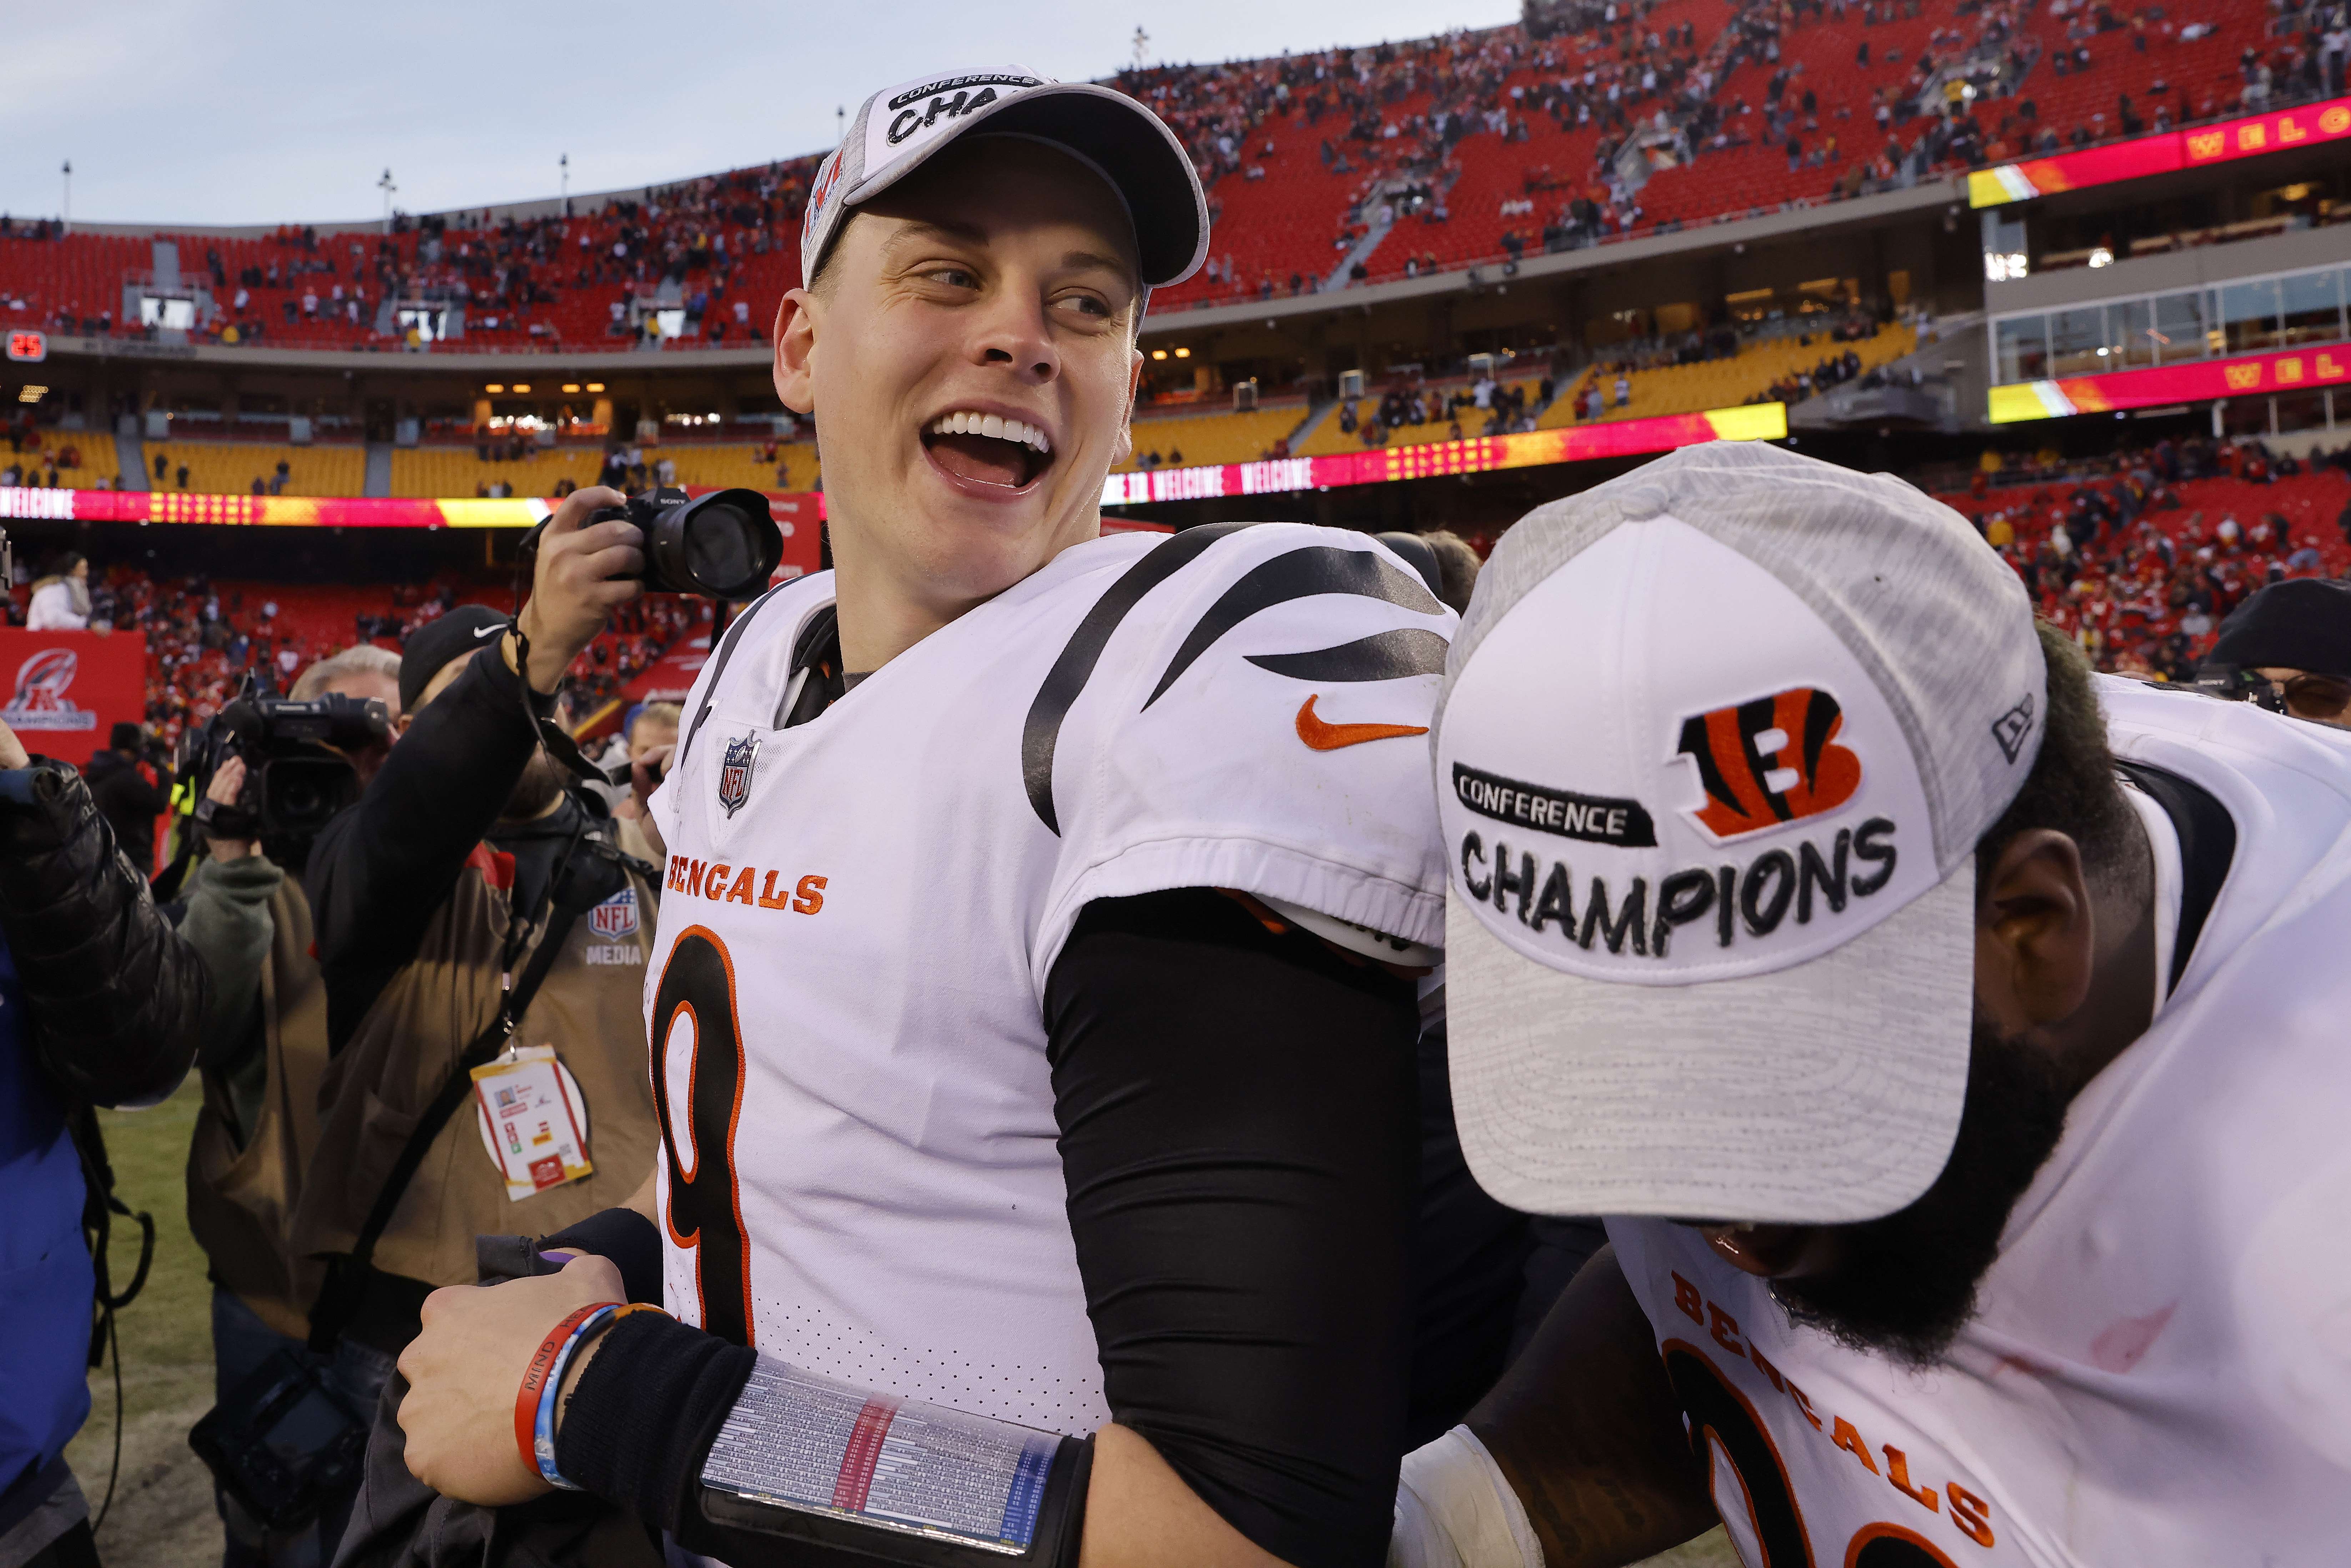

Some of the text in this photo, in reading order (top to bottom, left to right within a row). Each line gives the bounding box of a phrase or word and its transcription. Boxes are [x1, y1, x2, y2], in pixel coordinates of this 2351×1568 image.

[897, 74, 1036, 104] CONFERENCE
[887, 88, 1018, 143] CHA
[11, 334, 42, 358] 25
[722, 768, 744, 801] NFL
[1459, 774, 1628, 836] CONFERENCE
[667, 855, 829, 915] BENGALS
[1461, 817, 1898, 957] CHAMPIONS
[595, 907, 634, 931] NFL
[586, 946, 642, 965] MEDIA
[650, 924, 755, 1352] 9
[524, 1341, 555, 1391] MIND
[1671, 1270, 1995, 1548] BENGALS
